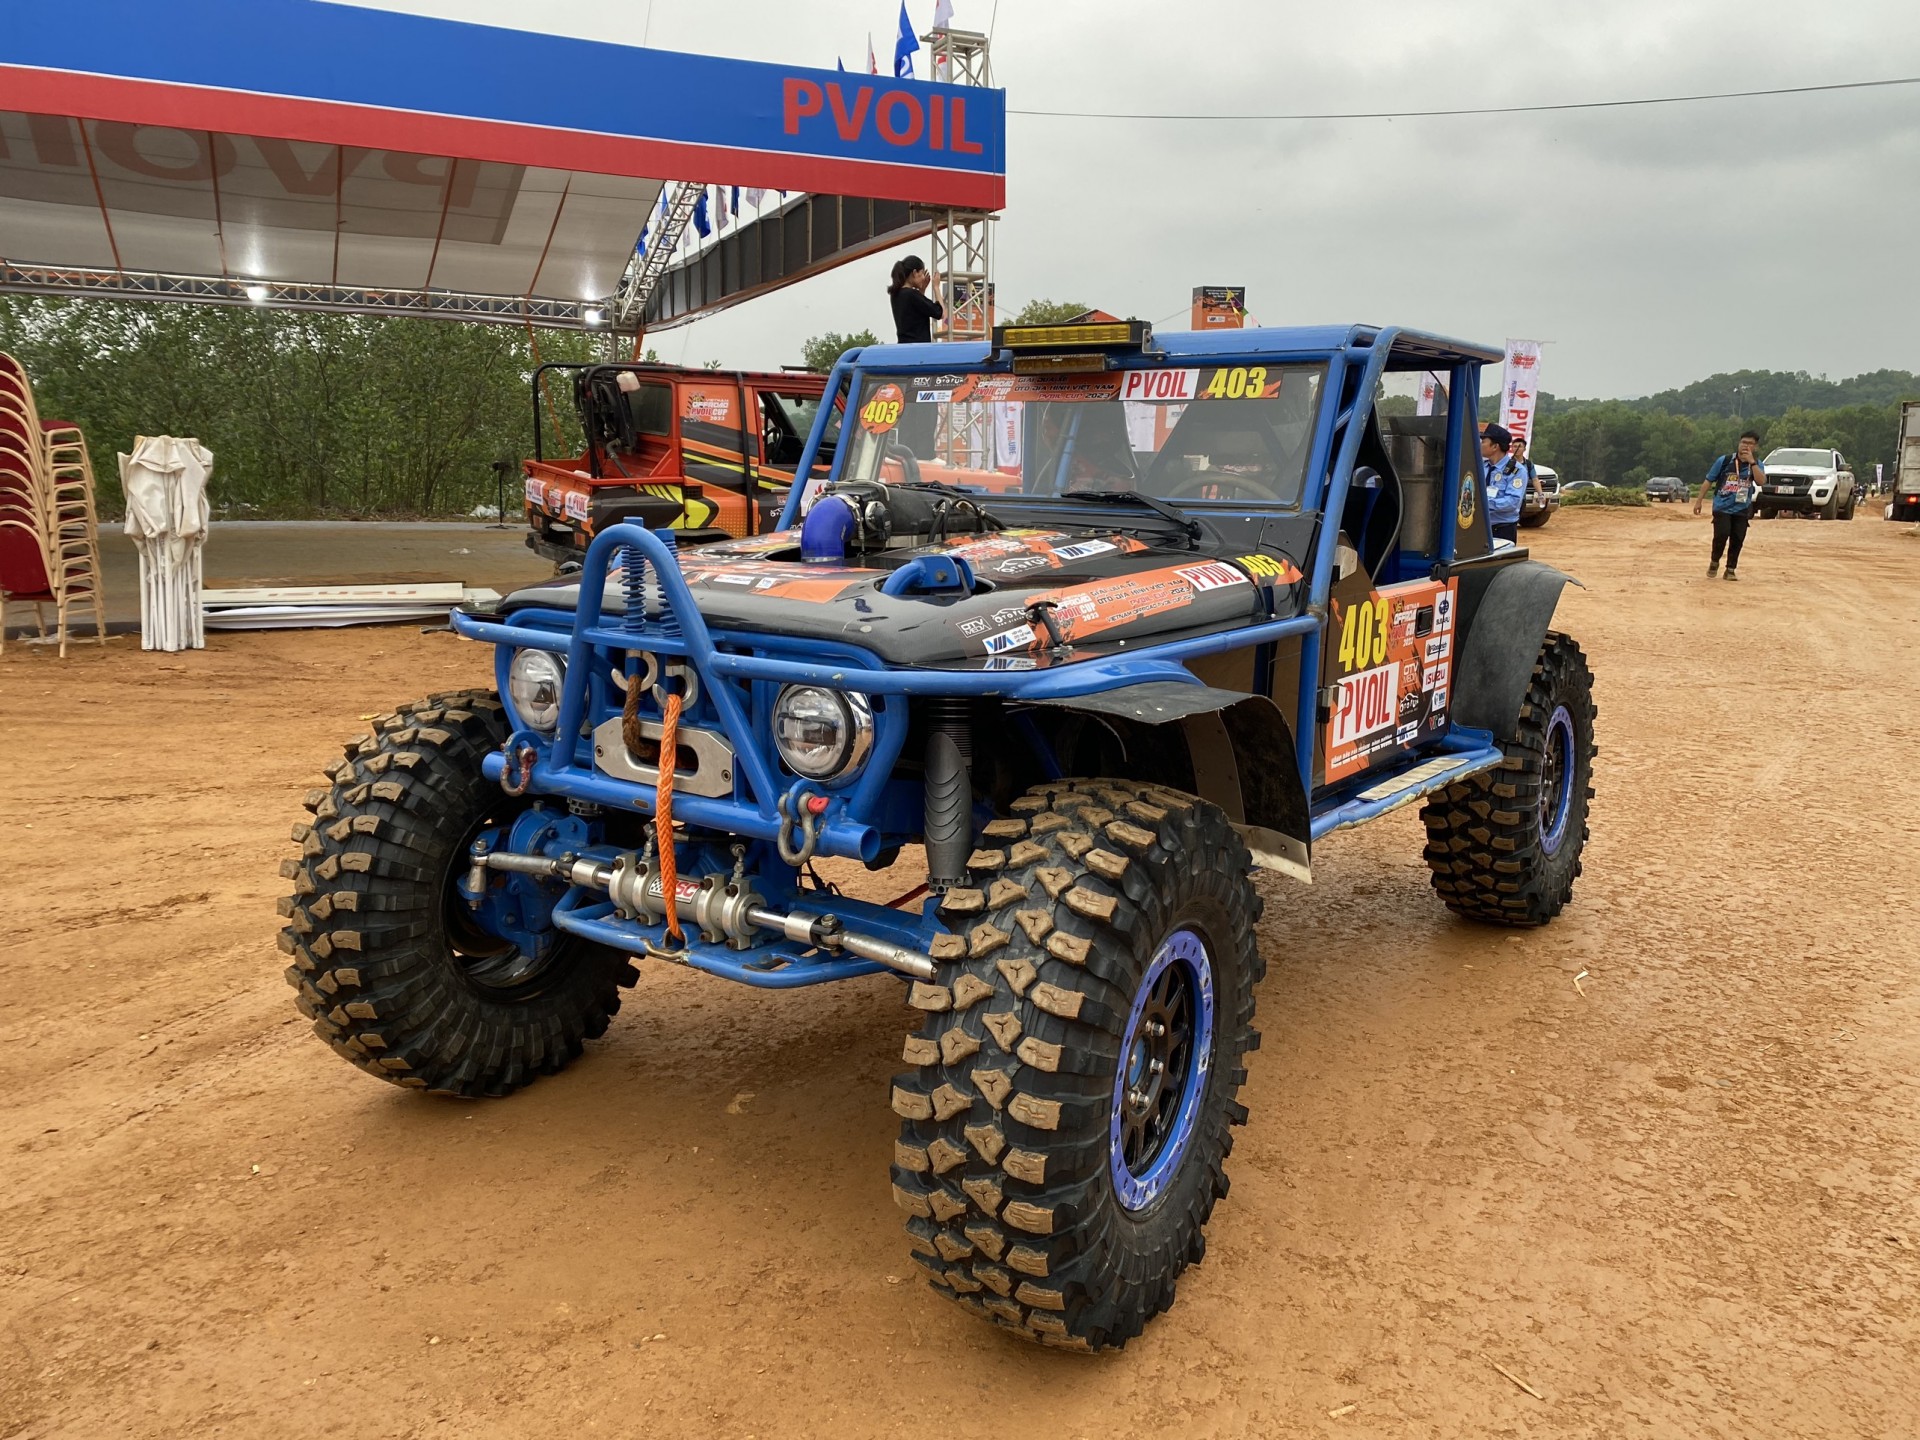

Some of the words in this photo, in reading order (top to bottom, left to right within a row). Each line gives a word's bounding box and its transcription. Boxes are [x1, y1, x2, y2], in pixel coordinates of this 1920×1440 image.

[783, 77, 984, 155] PVOIL
[978, 380, 1014, 388] OFFROAD
[995, 387, 1011, 396] CUP
[1126, 371, 1188, 398] PVOIL
[1207, 367, 1267, 399] 403
[863, 401, 899, 424] 403
[1183, 562, 1243, 588] PVOIL
[1236, 554, 1285, 577] 403
[1154, 591, 1168, 600] CUP
[1170, 586, 1190, 595] 2023
[1057, 608, 1081, 621] PVOIL
[1081, 602, 1096, 614] CUP
[1339, 598, 1389, 672] 403
[1425, 668, 1446, 685] ISUZU
[1339, 670, 1390, 740] PVOIL
